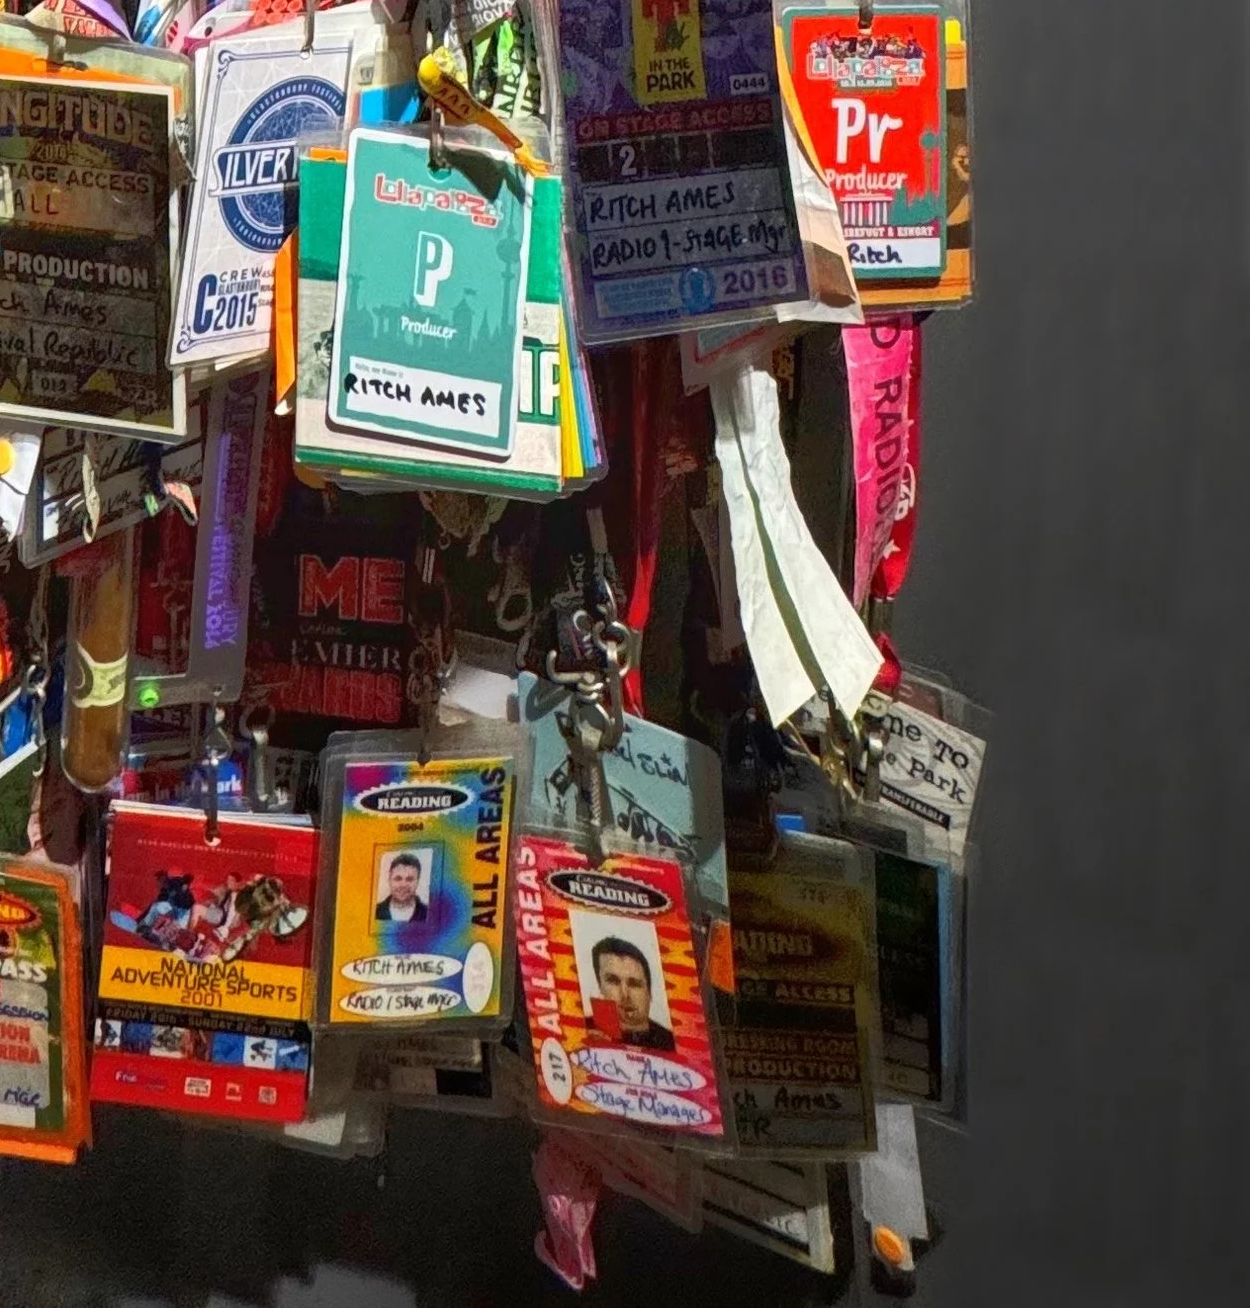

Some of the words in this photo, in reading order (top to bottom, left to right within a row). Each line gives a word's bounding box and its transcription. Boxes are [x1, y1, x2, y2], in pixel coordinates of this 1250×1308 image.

[647, 72, 695, 93] PARK
[831, 98, 901, 164] Pr
[827, 170, 906, 193] Producer
[589, 189, 657, 222] RITCH
[665, 182, 734, 212] AMES
[3, 249, 148, 287] PRODUCTION
[723, 267, 788, 295] 2016
[216, 299, 257, 329] 2015
[402, 317, 456, 339] Producer
[344, 374, 413, 404] RITCH
[421, 390, 485, 416] AMES
[872, 381, 905, 523] RADIO
[299, 554, 404, 622] ME
[907, 758, 967, 804] Park
[376, 794, 453, 810] READING
[471, 767, 506, 869] AREAS
[471, 872, 498, 931] ALL
[516, 846, 550, 962] AREAS
[568, 881, 651, 907] READING
[110, 965, 221, 987] ADVENTURE
[228, 981, 299, 1001] SPORTS
[160, 956, 251, 981] NATIONAL
[533, 975, 562, 1036] ALL
